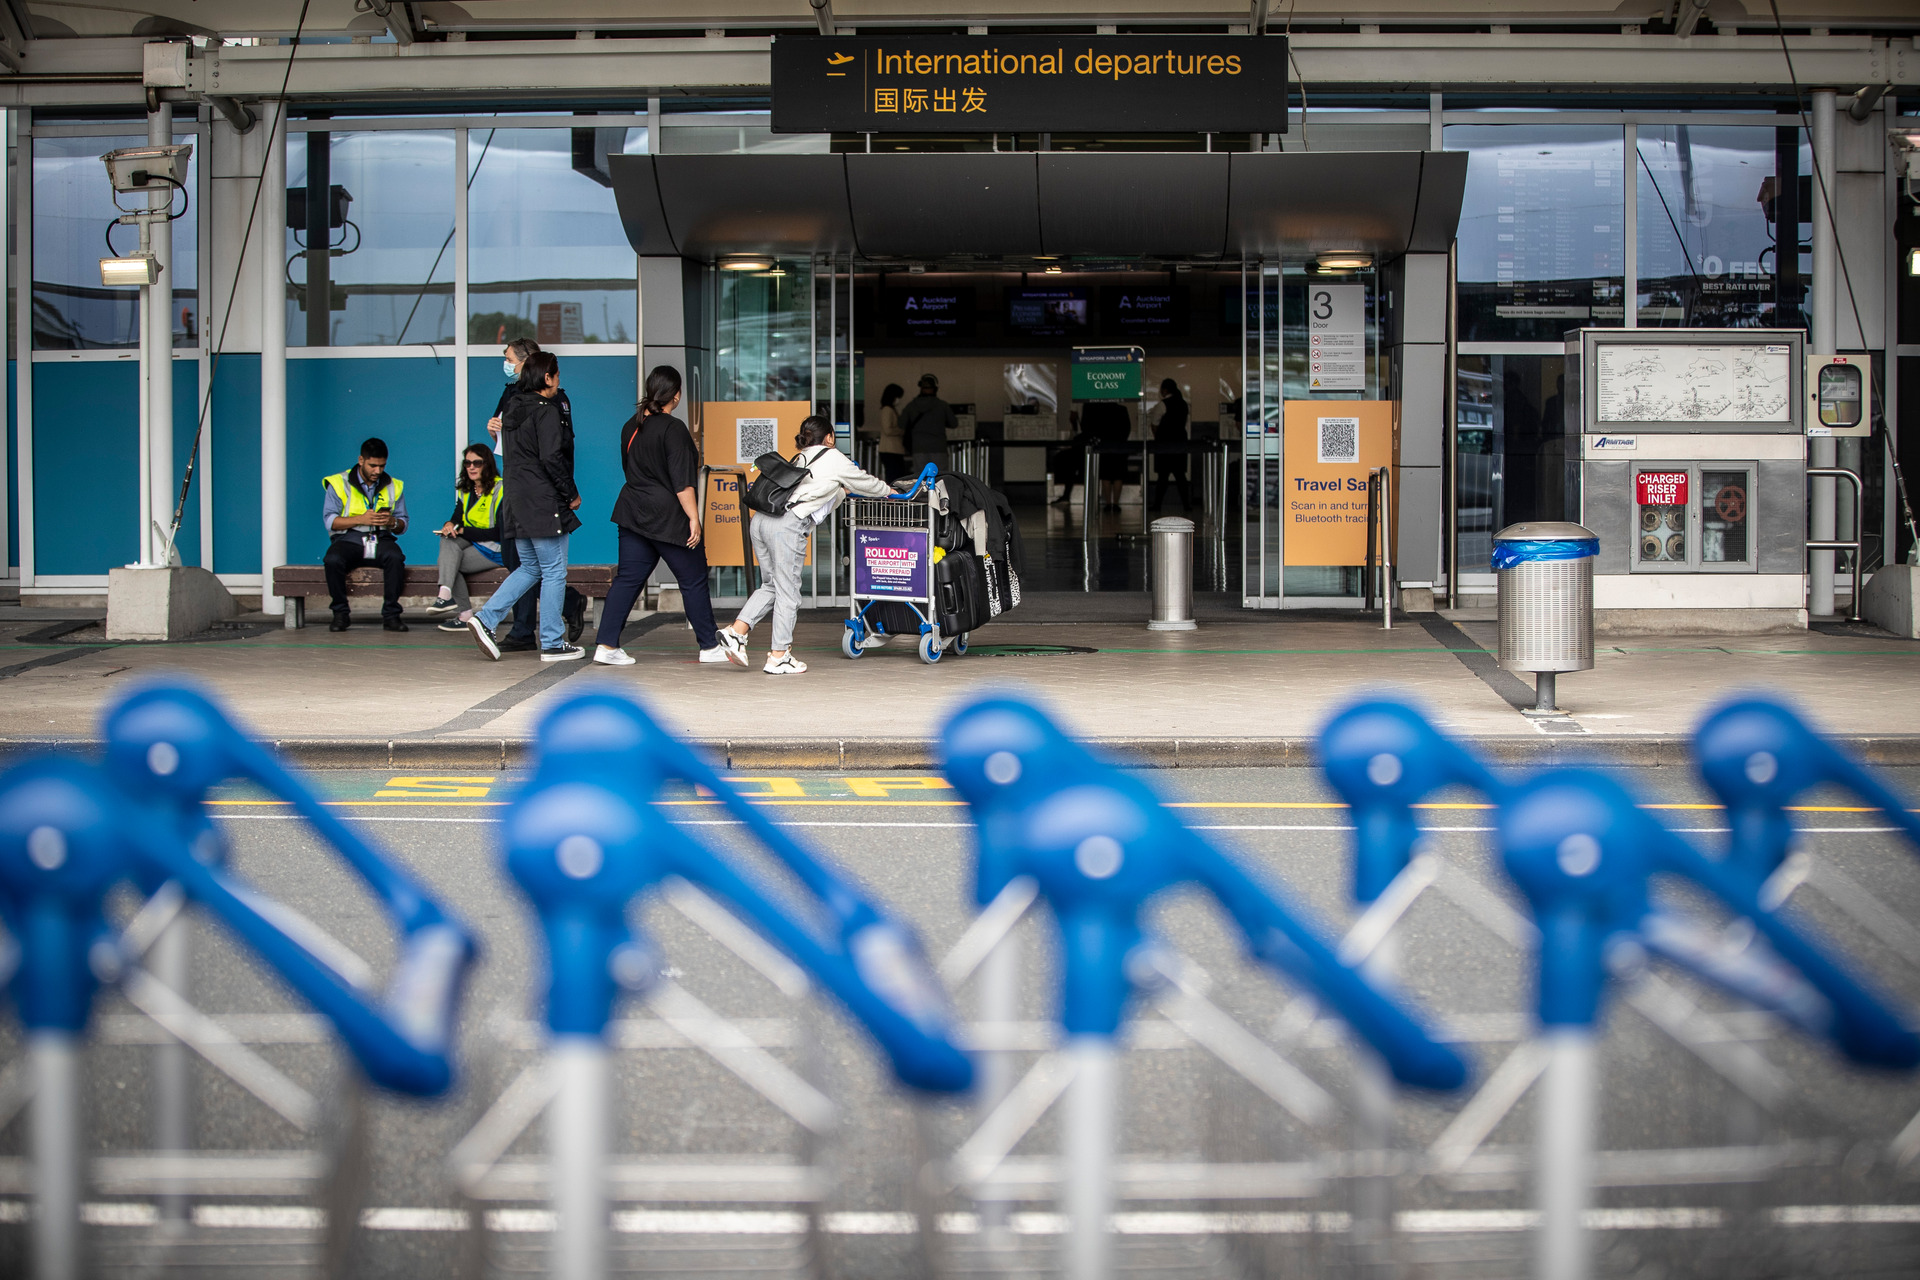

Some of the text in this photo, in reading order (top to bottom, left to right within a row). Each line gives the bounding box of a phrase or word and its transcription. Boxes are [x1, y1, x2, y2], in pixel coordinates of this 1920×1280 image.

[877, 48, 1242, 80] International departures
[874, 86, 987, 113] 国际出发
[1730, 262, 1771, 280] FEE
[1313, 292, 1332, 320] 3
[1087, 372, 1126, 380] ECONOMY
[1094, 381, 1119, 389] CLASS
[1594, 437, 1634, 448] ARMITAGE
[1638, 474, 1685, 484] CHARGED
[1294, 478, 1342, 491] Travel
[1647, 485, 1676, 494] RISER
[1648, 494, 1676, 504] INLET
[711, 502, 735, 510] Scan
[1291, 501, 1316, 510] Scan
[1318, 502, 1327, 510] in
[1330, 502, 1348, 510] and
[1296, 514, 1342, 523] Bluetooth
[865, 548, 887, 558] ROLL
[888, 549, 907, 558] OUT
